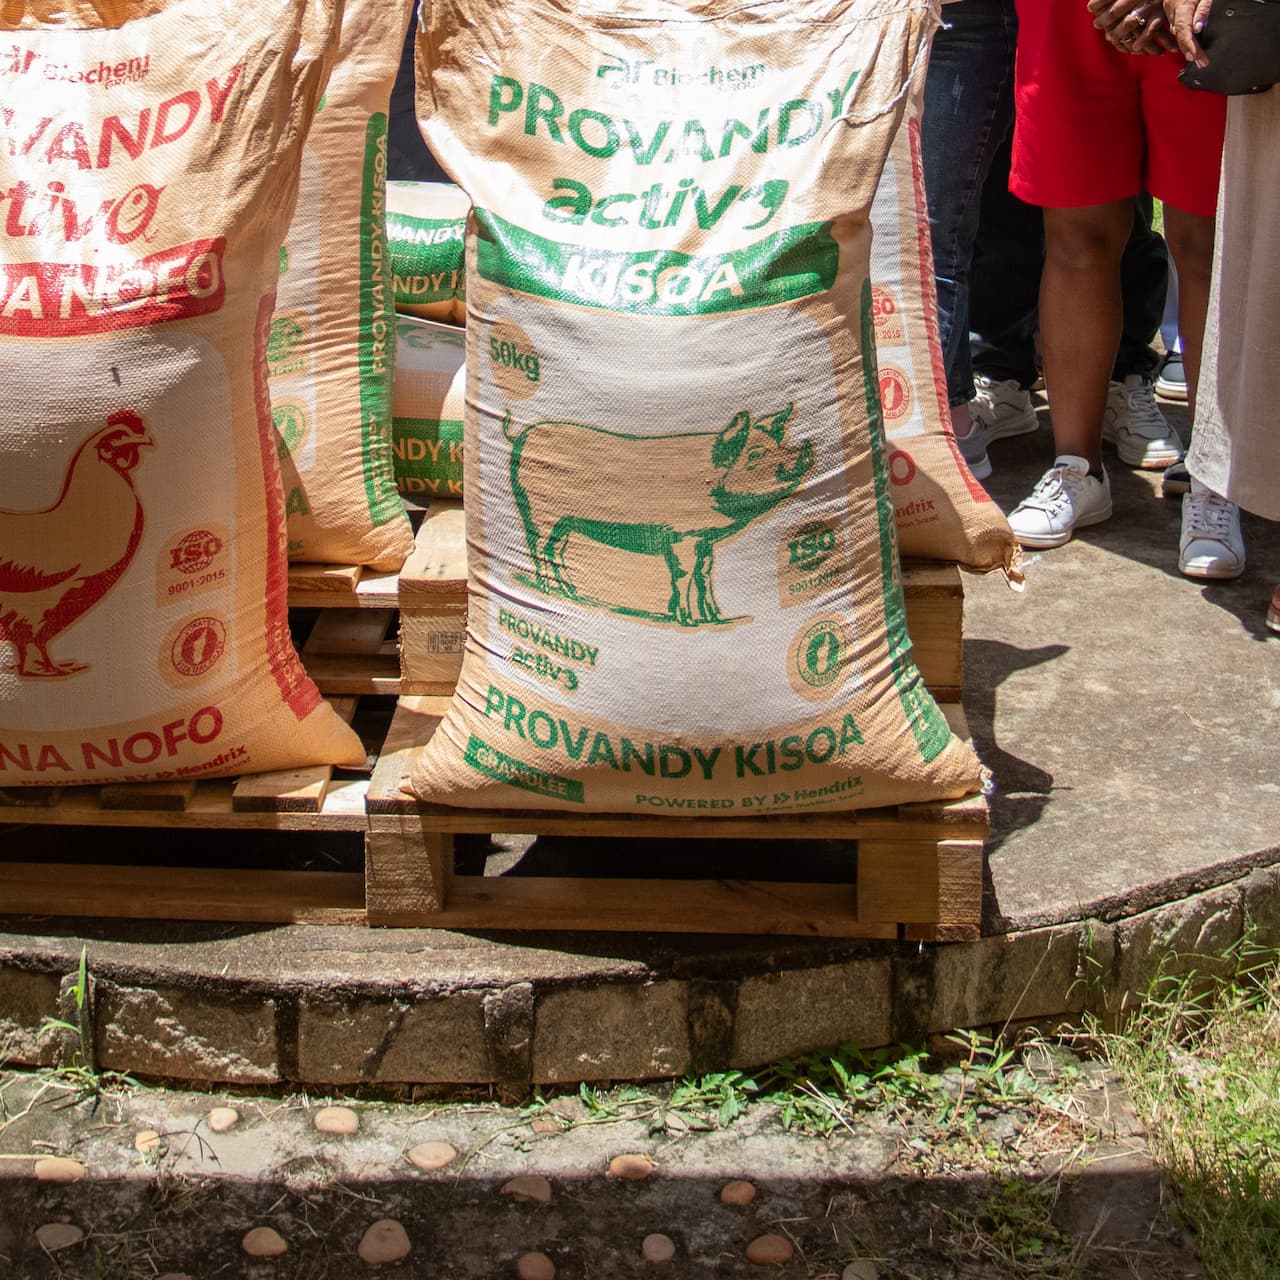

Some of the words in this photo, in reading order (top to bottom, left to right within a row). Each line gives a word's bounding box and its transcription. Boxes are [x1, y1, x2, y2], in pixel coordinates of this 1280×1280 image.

[487, 69, 862, 166] PROVANDY
[58, 251, 219, 319] NOFO
[368, 219, 389, 375] PROVANDY
[561, 251, 746, 305] KISOA
[489, 336, 540, 382] 50kg
[895, 499, 935, 518] ndrix
[170, 536, 224, 569] ISO
[787, 528, 836, 565] ISO
[168, 568, 225, 596] 9001:2015
[498, 609, 600, 666] PROVANDY
[80, 706, 224, 770] NOFO
[485, 684, 721, 781] PROVANDY
[735, 713, 865, 779] KISOA
[175, 744, 248, 776] Hendrix
[635, 793, 735, 810] POWERED
[740, 794, 768, 808] BY
[793, 775, 864, 801] Hendrix
